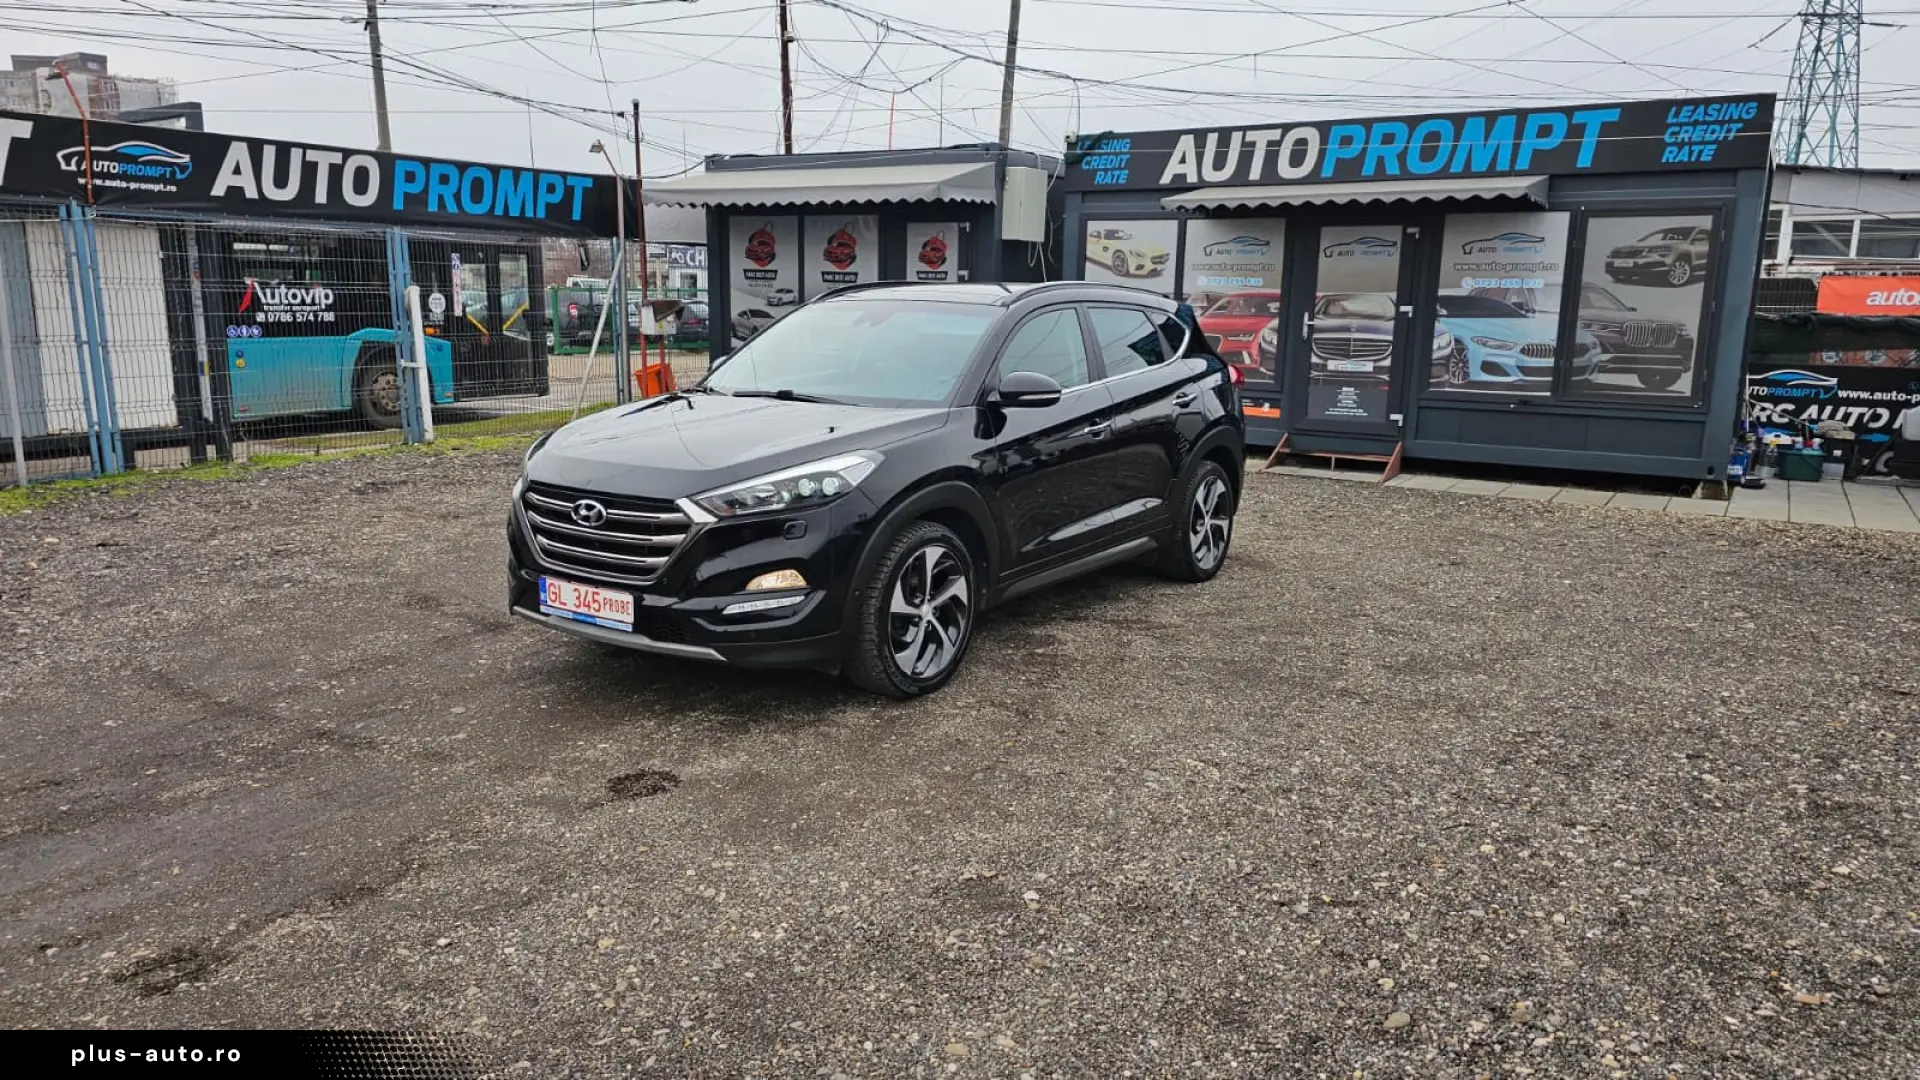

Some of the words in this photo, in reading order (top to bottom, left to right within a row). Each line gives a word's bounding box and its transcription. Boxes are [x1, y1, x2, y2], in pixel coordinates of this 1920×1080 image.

[1665, 101, 1758, 123] LEASING
[1663, 123, 1743, 143] CREDIT
[1081, 154, 1131, 170] CREDIT
[1661, 144, 1717, 162] RATE
[210, 141, 380, 207] AUTO
[393, 159, 593, 221] PROMPT
[1094, 169, 1129, 185] RATE
[238, 278, 334, 312] Autovip
[296, 312, 314, 322] 574
[1800, 404, 1891, 429] AUTO
[547, 582, 567, 606] GL
[573, 588, 601, 613] 345
[603, 597, 632, 616] PROBE
